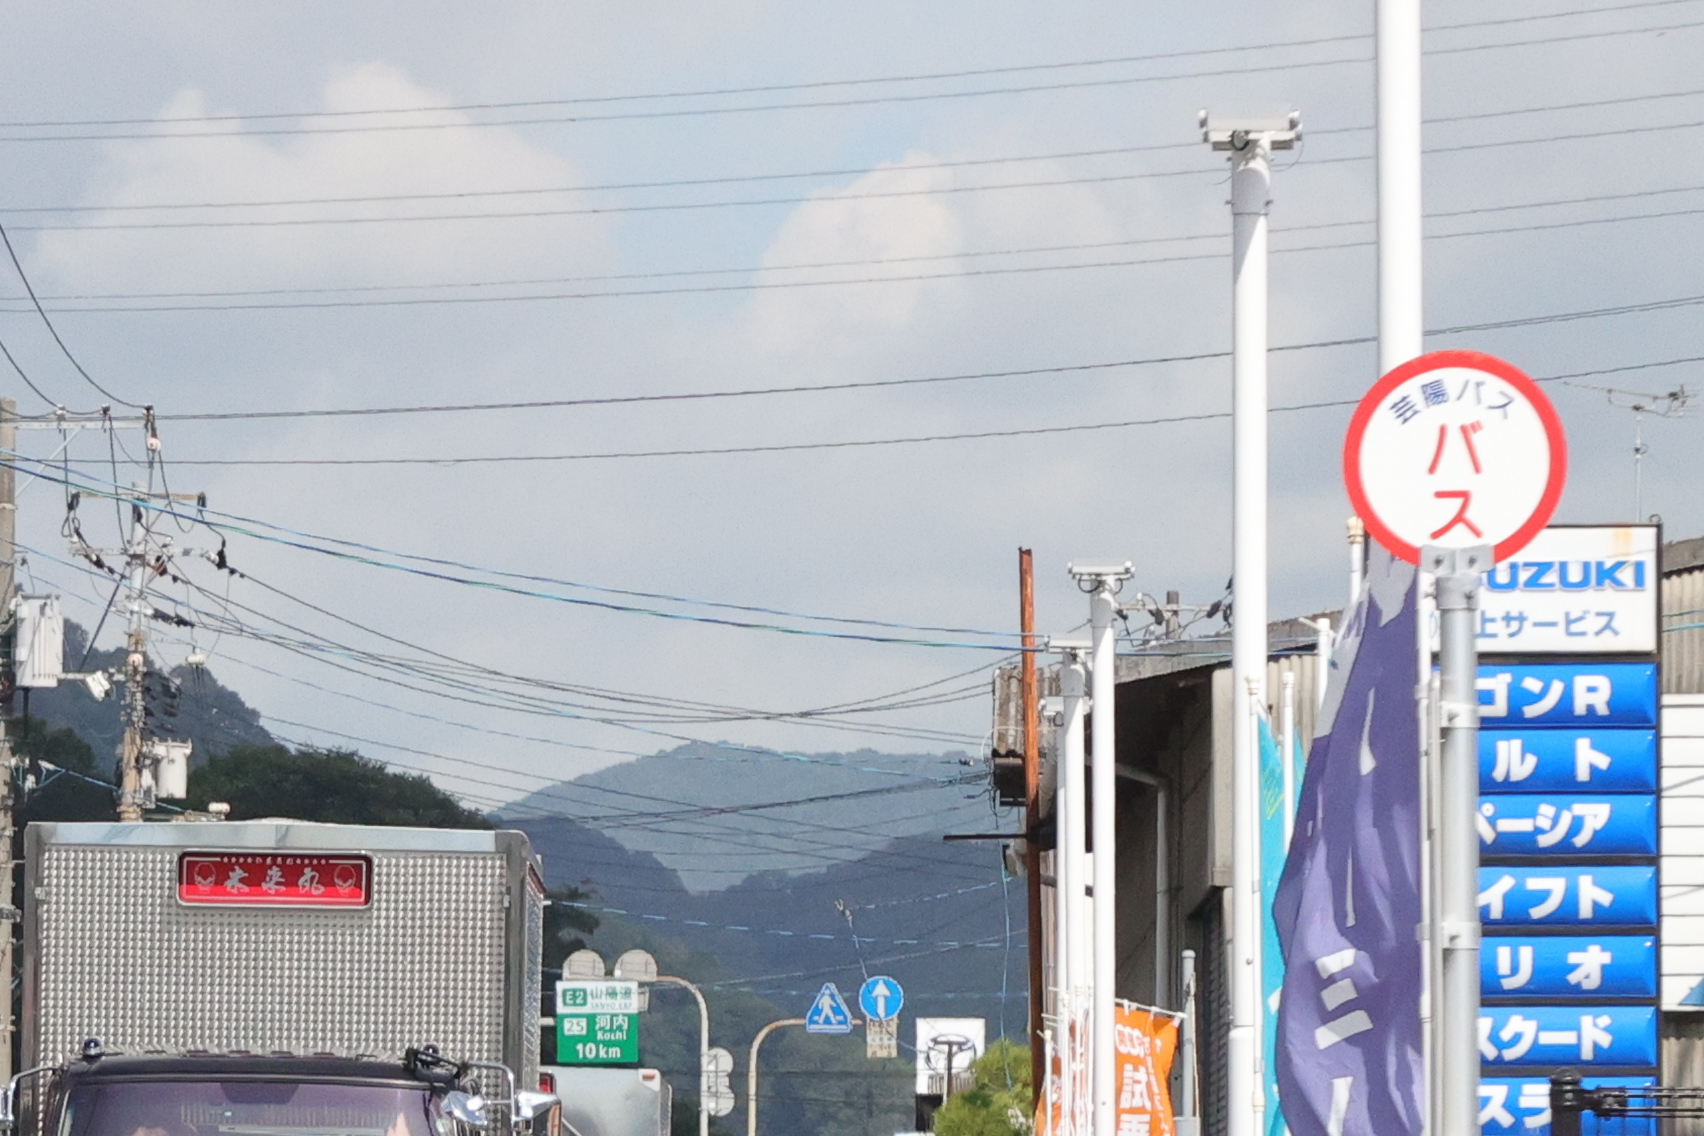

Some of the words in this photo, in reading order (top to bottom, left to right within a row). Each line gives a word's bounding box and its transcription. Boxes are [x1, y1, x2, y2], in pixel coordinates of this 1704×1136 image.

[1389, 378, 1515, 425] 芸陽バス
[1427, 419, 1484, 540] バス
[1482, 560, 1647, 591] UZUKI
[1475, 610, 1621, 638] 上サービス
[1477, 672, 1612, 718] ゴンR
[1491, 737, 1613, 782] ルト
[1476, 802, 1612, 848] ペーシア
[1476, 874, 1615, 919] イフト
[1496, 944, 1612, 990] リオ
[565, 991, 585, 1004] E2
[590, 986, 633, 1001] 山陽道
[566, 1019, 585, 1033] 25
[595, 1014, 629, 1031] 河内
[597, 1030, 627, 1041] Kochi
[1477, 1014, 1613, 1061] スクード
